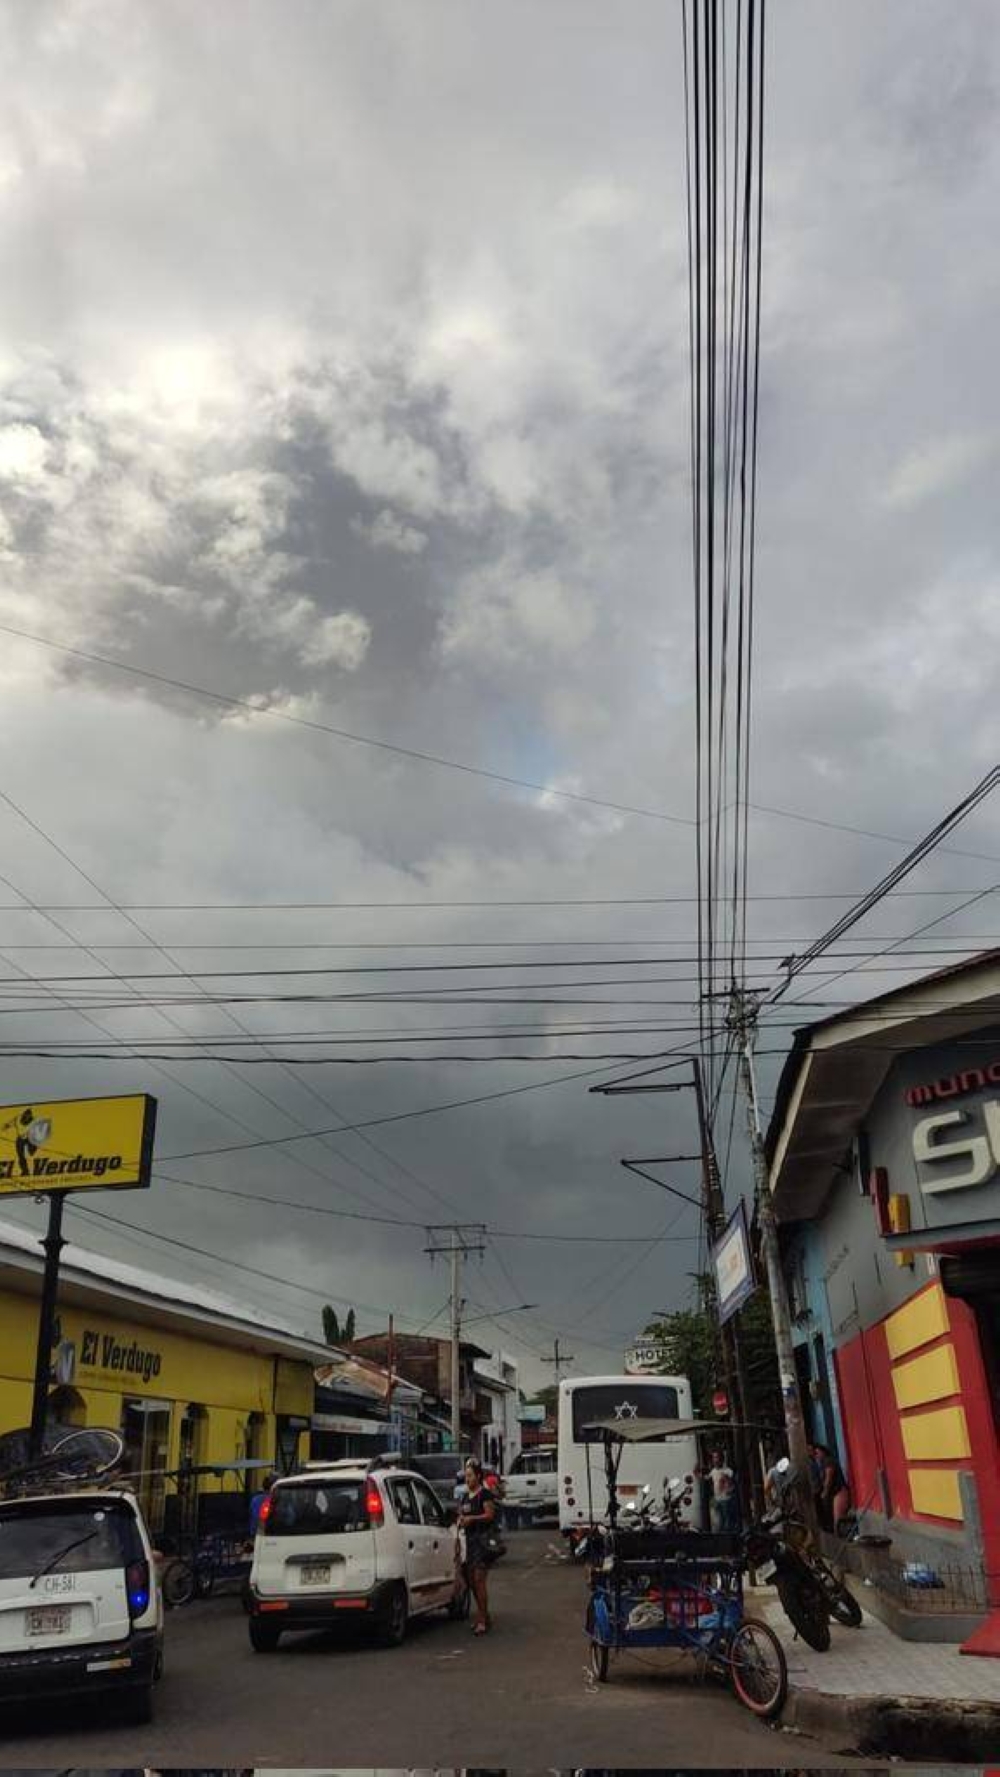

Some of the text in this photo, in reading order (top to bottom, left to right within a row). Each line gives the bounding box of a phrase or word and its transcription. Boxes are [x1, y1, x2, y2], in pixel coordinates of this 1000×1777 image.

[33, 1156, 121, 1176] Verdugo
[913, 1100, 1000, 1194] S
[80, 1330, 162, 1384] El Verdugo
